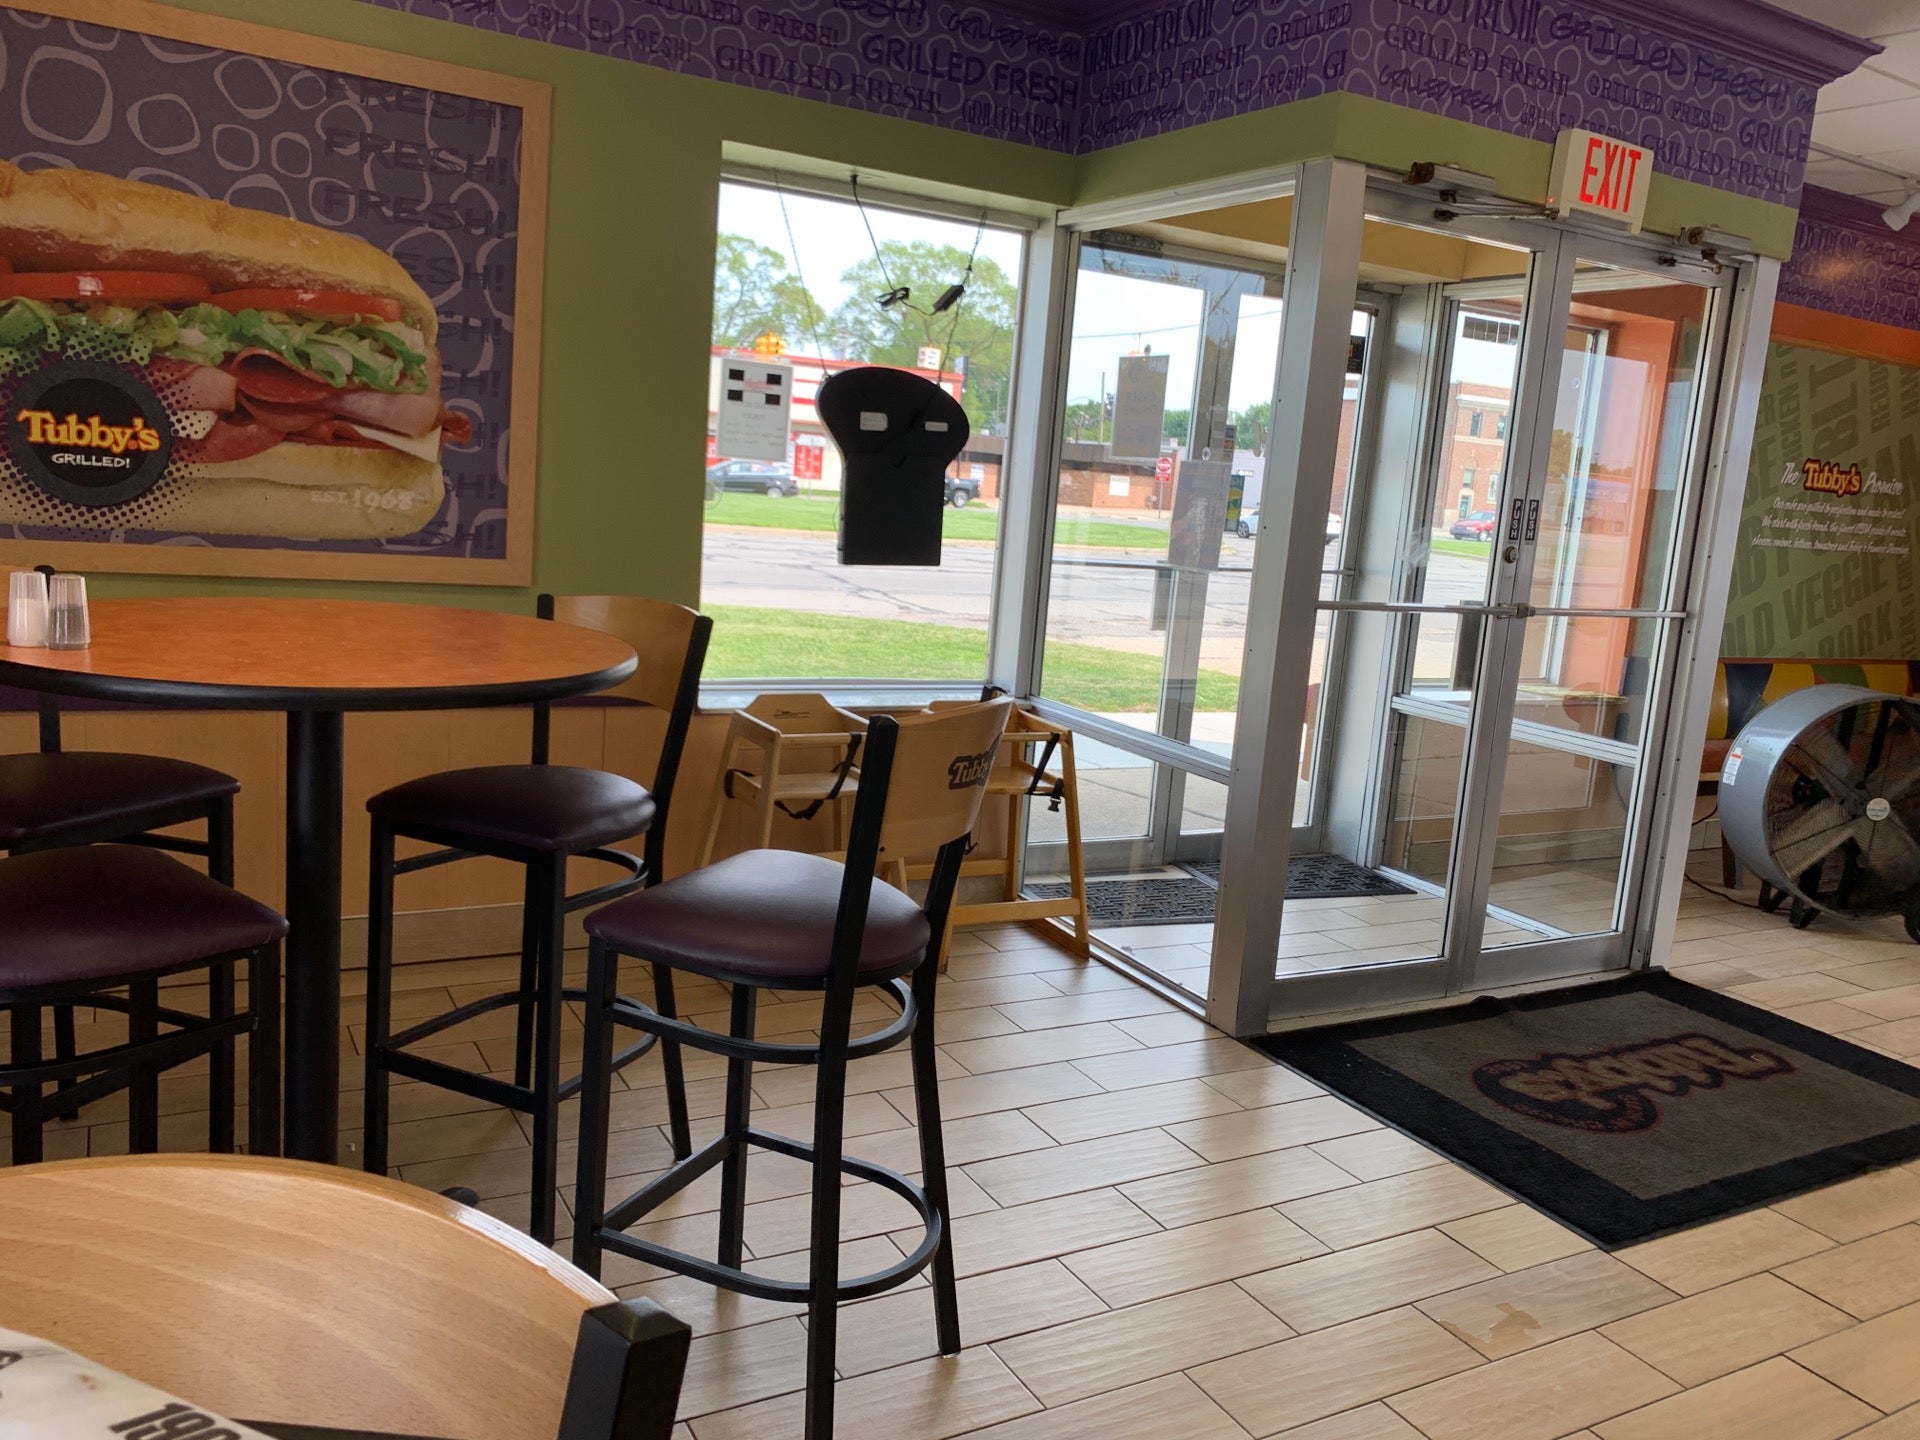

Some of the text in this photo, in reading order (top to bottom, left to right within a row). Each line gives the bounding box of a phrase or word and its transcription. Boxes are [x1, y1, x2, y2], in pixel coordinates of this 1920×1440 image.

[1265, 3, 1353, 49] GRILLED
[1384, 22, 1489, 73] GRILLED
[716, 44, 843, 92] GRILLED
[862, 34, 986, 85] GRILLED
[324, 126, 509, 186] FRESH!
[1739, 117, 1809, 163] GRILLE
[1579, 137, 1641, 212] EXIT
[322, 184, 508, 239] FRESH!
[393, 250, 505, 292] ESH!
[436, 310, 503, 343] SH!
[16, 408, 161, 455] Tubby's
[51, 453, 131, 469] GRILLED!
[1781, 462, 1800, 485] The
[1803, 460, 1861, 498] Tubby's
[352, 486, 416, 513] 1968
[1510, 501, 1521, 539] PUSH
[1527, 501, 1537, 539] PUSH
[1722, 601, 1775, 658] OLD
